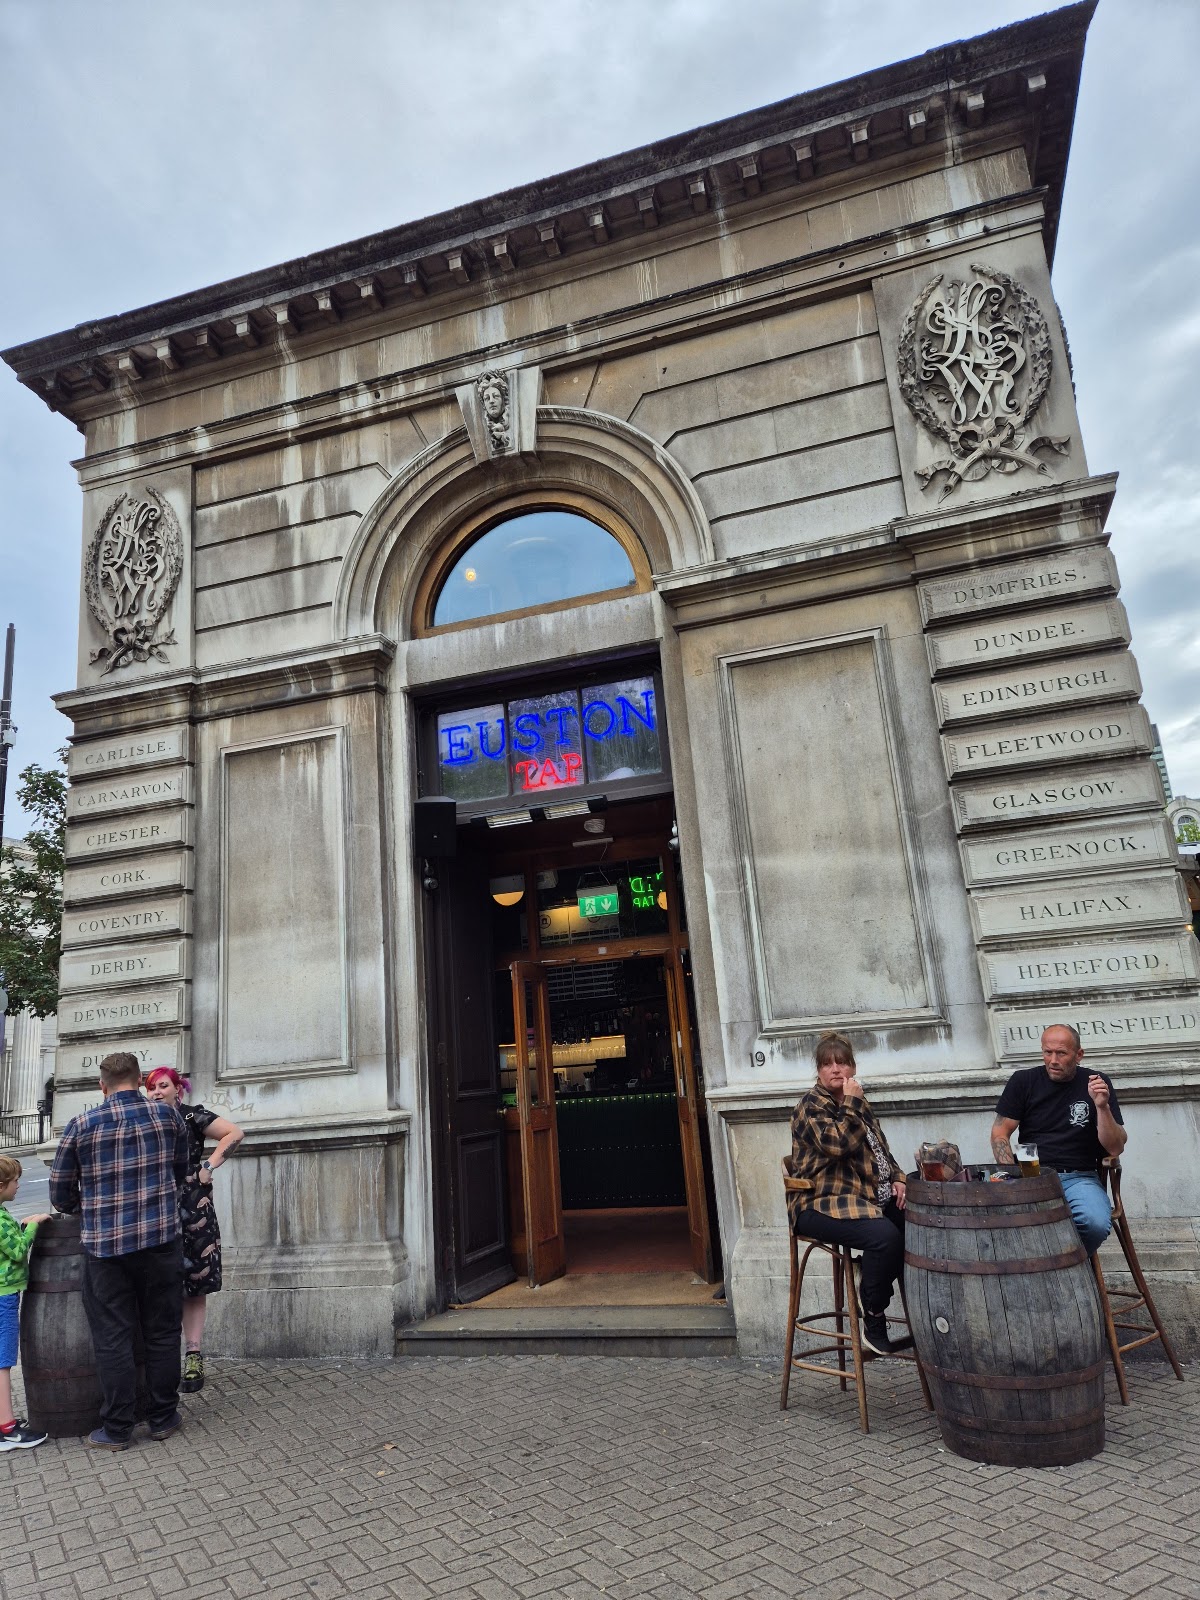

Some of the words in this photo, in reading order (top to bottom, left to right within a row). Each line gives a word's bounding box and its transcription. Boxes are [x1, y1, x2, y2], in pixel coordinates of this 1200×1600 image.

[954, 569, 1086, 604] DUMFRIES.
[974, 622, 1085, 652] DUNDEE.
[963, 670, 1116, 707] EDINBURGH.
[440, 690, 656, 767] EUSTON
[85, 741, 172, 765] CARLISLE.
[966, 724, 1130, 760] FLEETWOOD.
[515, 753, 583, 790] TAP
[78, 780, 176, 807] CARNARVON.
[992, 781, 1124, 810] GLASGOW.
[86, 825, 167, 846] CHESTER.
[996, 836, 1146, 866] GREENOCK.
[100, 869, 151, 887] CORK.
[1019, 896, 1142, 921] HALIFAX.
[78, 911, 168, 933] COVENTRY.
[91, 957, 152, 976] DERBY.
[1018, 954, 1169, 980] HEREFORD.
[74, 1002, 167, 1023] DEWSBURY.
[1008, 1013, 1196, 1041] HUERSFIELD
[81, 1049, 153, 1068] DUY.
[749, 1051, 766, 1067] 19
